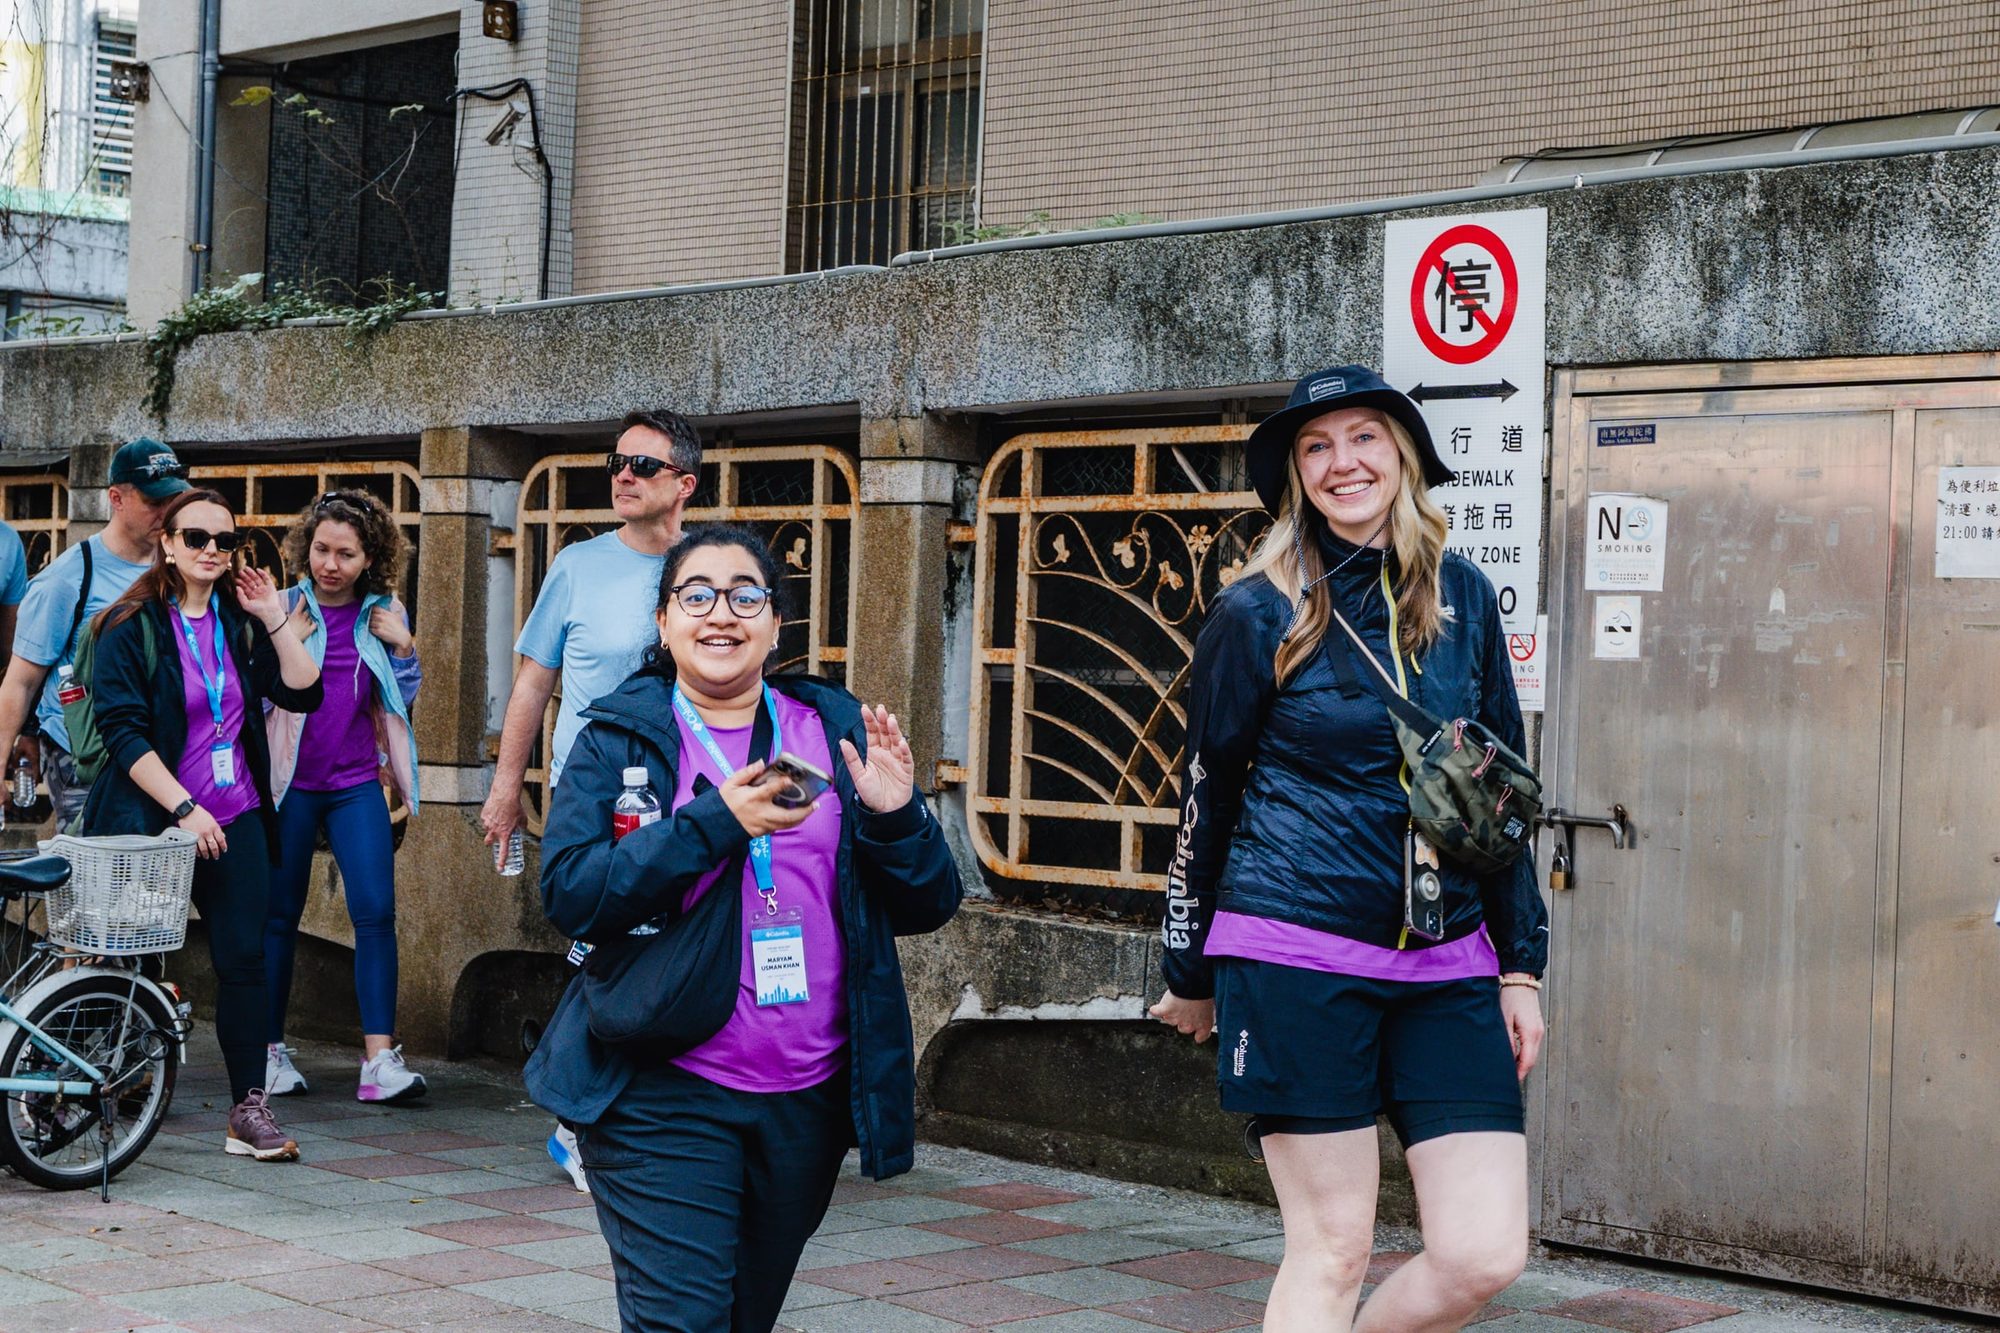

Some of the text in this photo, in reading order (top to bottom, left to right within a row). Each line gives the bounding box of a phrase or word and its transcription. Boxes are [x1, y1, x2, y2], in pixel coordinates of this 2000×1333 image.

[1434, 258, 1492, 334] 停
[1943, 525, 2000, 541] 21:00 請
[1480, 546, 1521, 563] ZONE
[1597, 544, 1652, 553] SMOKING
[760, 962, 800, 972] USMAN KHAN
[767, 955, 793, 964] MARYAM
[1238, 1038, 1249, 1076] Columbia
